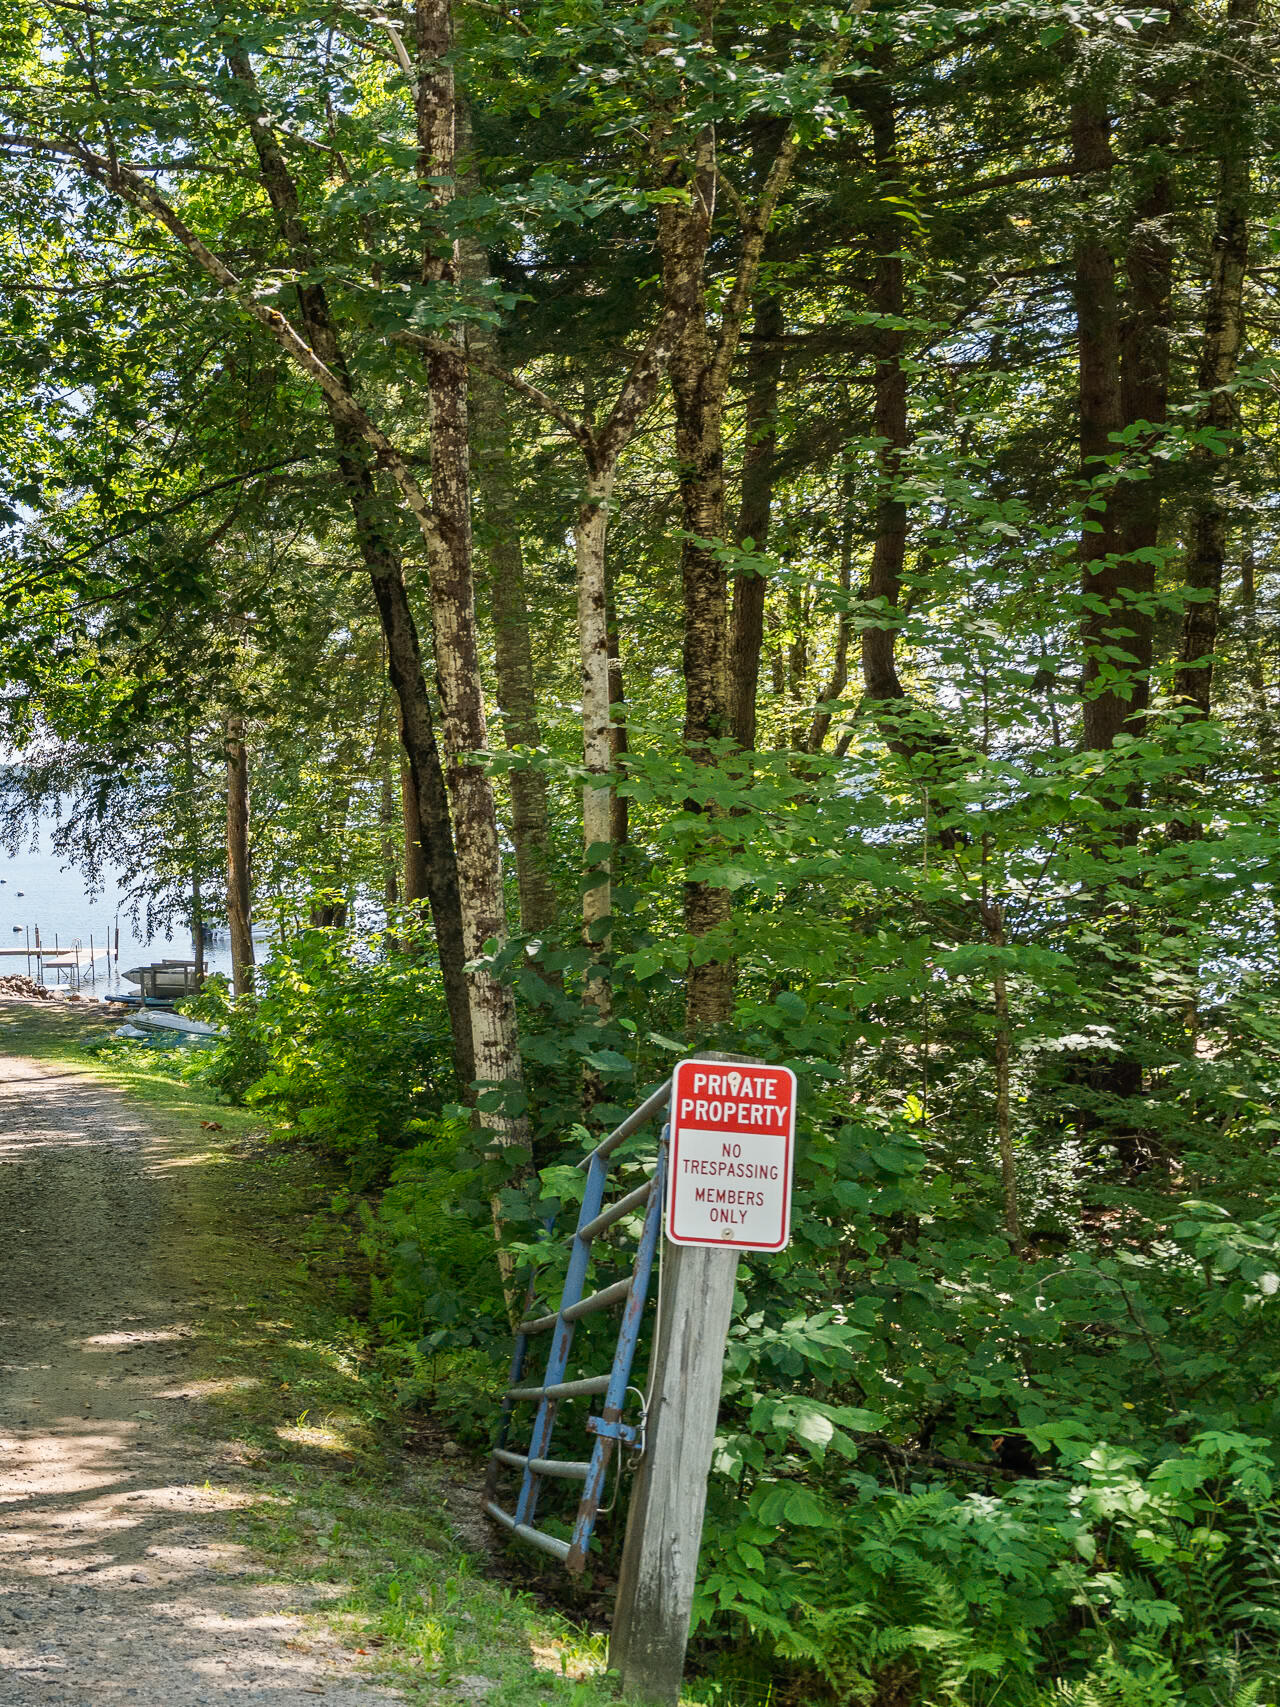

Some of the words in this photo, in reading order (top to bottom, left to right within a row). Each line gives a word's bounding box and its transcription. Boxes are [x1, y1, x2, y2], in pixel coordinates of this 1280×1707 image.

[680, 1099, 788, 1127] PROPERTY
[721, 1143, 742, 1159] NO
[683, 1159, 779, 1180] TRESPASSING
[695, 1187, 764, 1206] MEMBERS
[709, 1208, 748, 1224] ONLY
